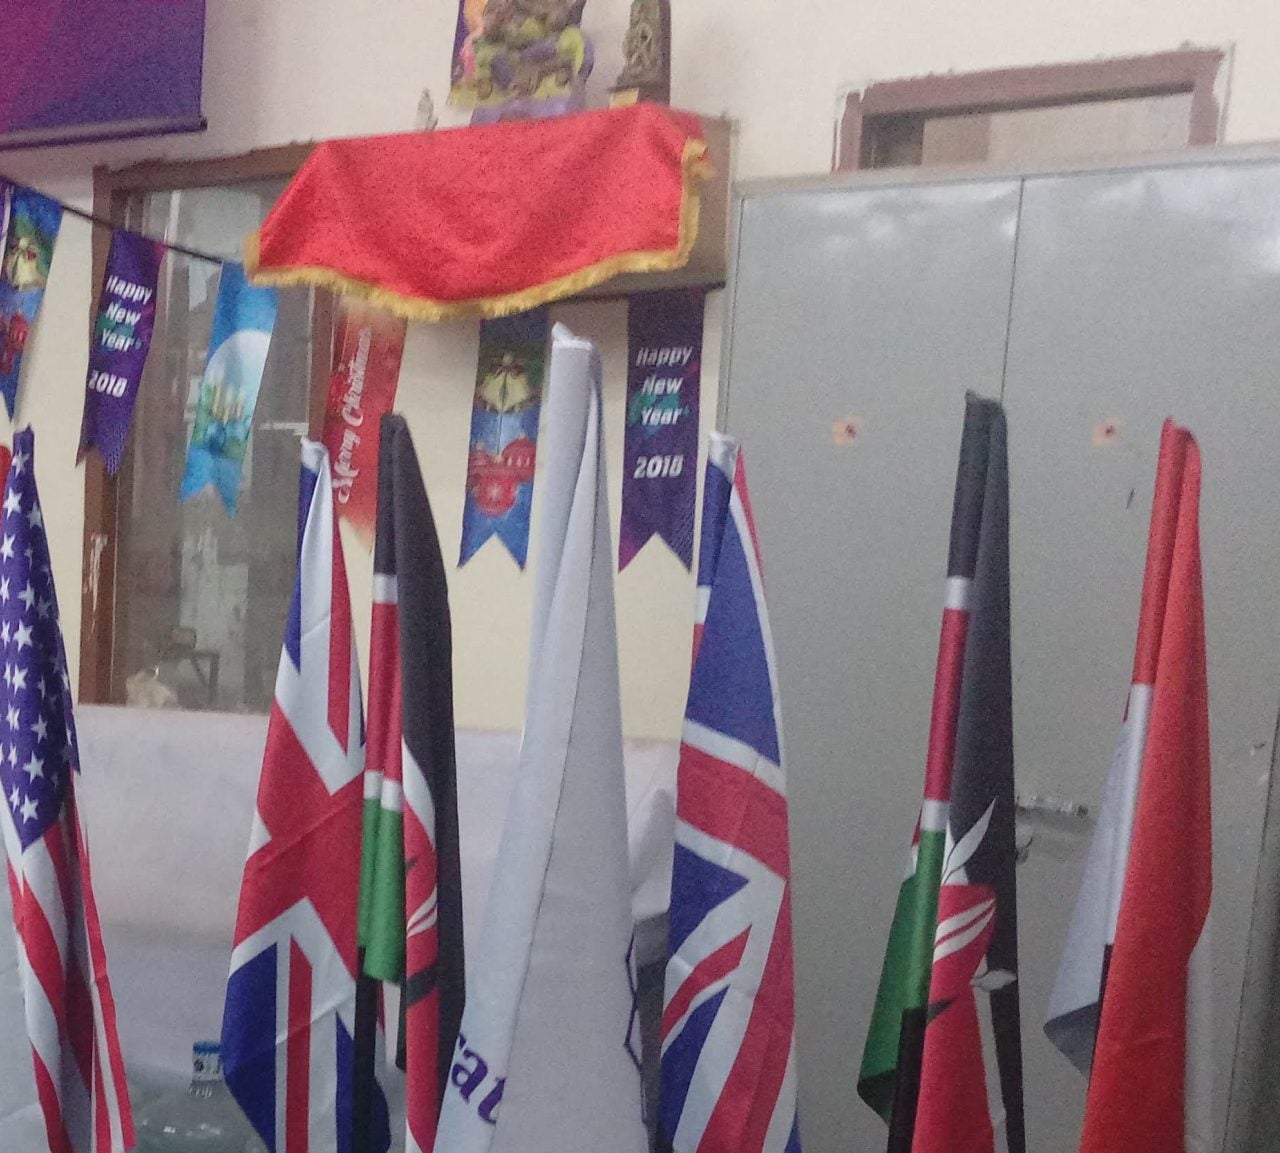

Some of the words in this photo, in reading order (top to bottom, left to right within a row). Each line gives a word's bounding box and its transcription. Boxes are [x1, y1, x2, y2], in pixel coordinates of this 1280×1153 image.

[105, 274, 153, 305] Happy
[106, 300, 141, 326] New
[101, 328, 134, 351] Year
[635, 345, 694, 367] Happy
[641, 374, 683, 395] New
[641, 406, 683, 426] Year
[633, 454, 684, 479] 2018
